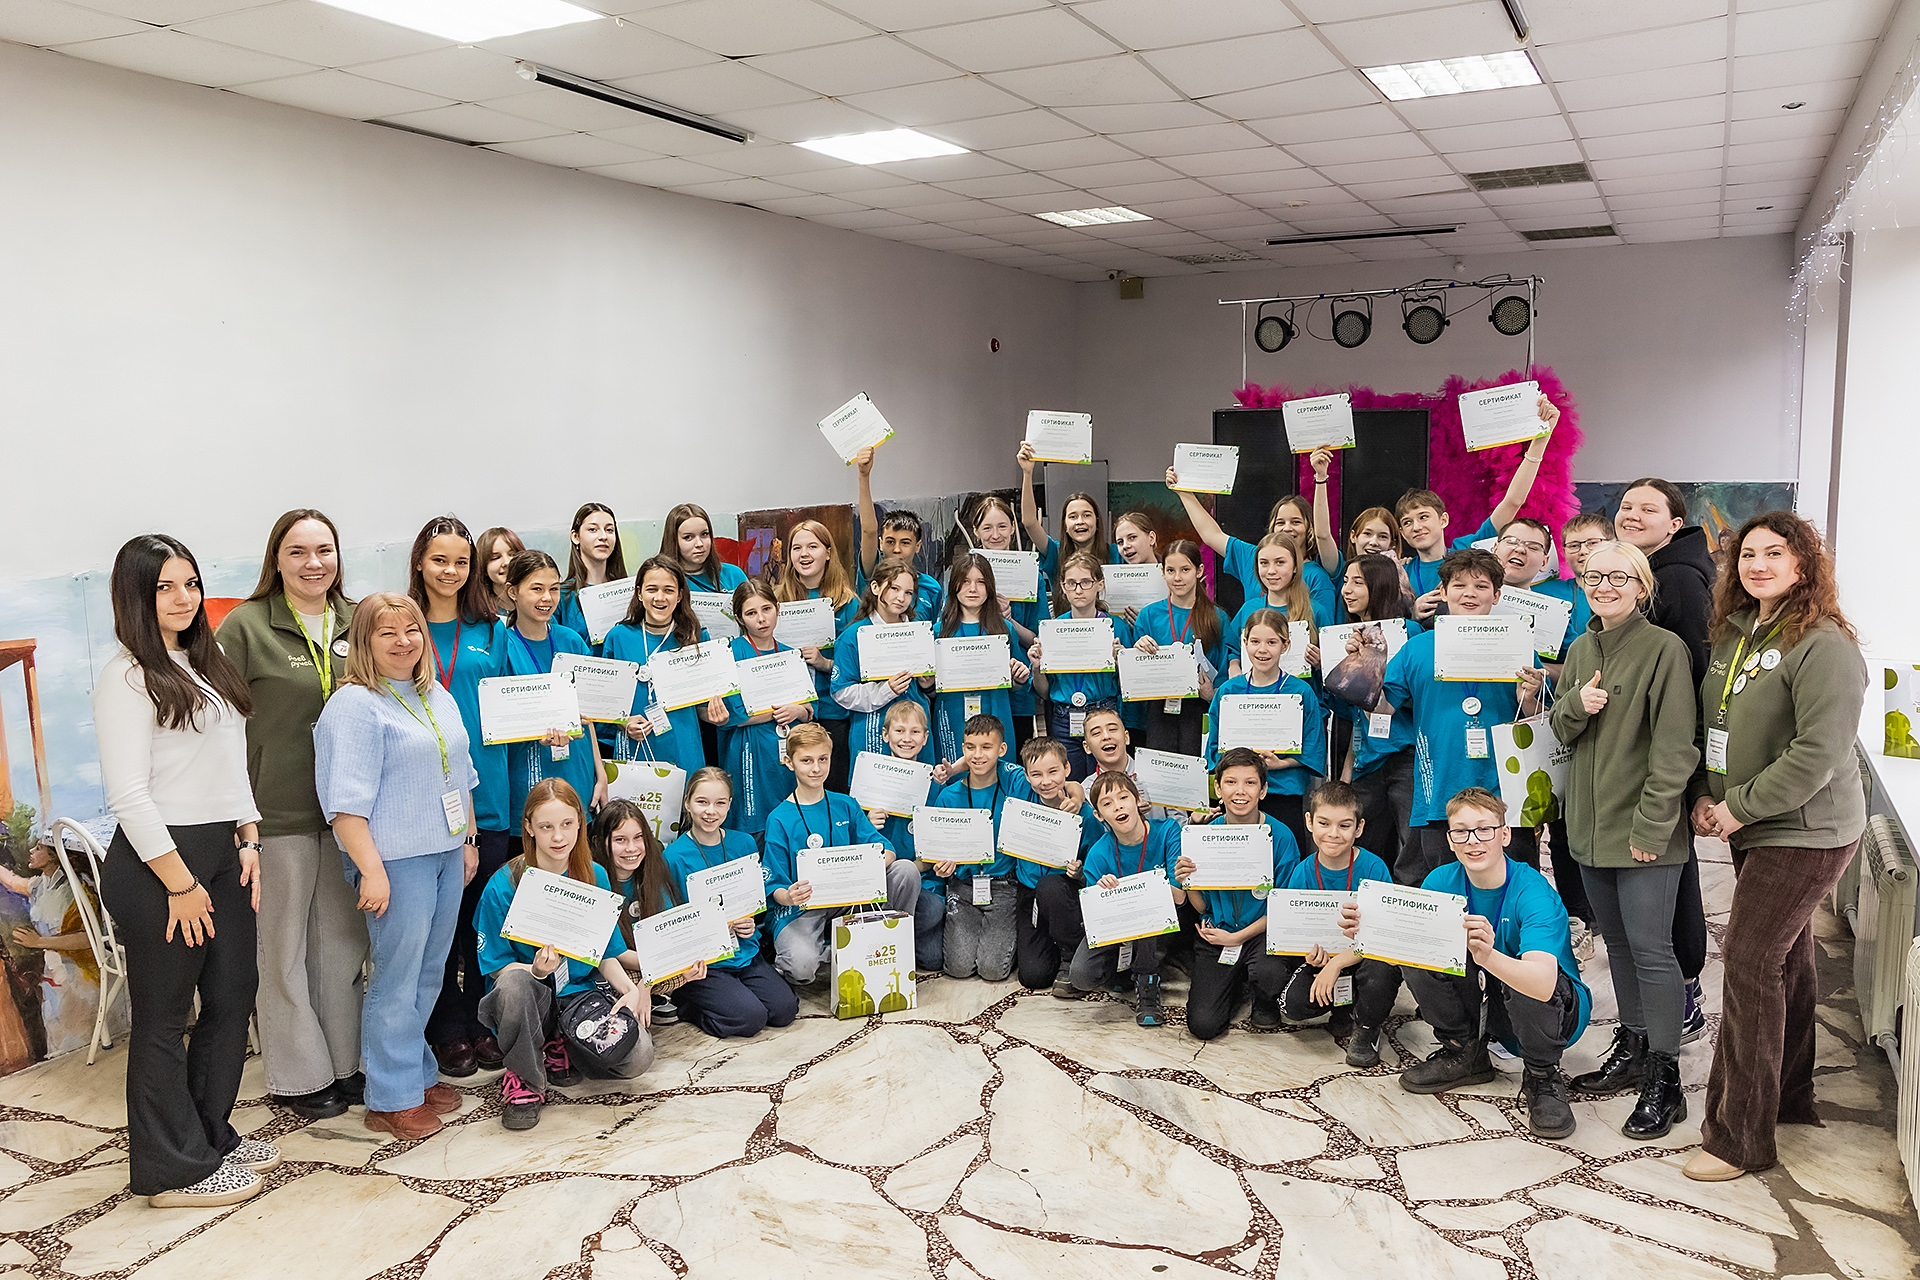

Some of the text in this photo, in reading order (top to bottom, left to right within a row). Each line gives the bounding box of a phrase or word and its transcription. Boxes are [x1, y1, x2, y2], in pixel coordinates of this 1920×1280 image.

[1478, 392, 1522, 406] СЕРТИФИКАТ
[1296, 404, 1333, 414] СЕРТИФИКАТ
[832, 407, 859, 428] СЕРТИФИКАТ
[1041, 418, 1075, 427] СЕРТИФИКАТ
[1189, 451, 1223, 459] СЕРТИФИКАТ
[598, 586, 635, 600] СЕРТИФИКА
[1502, 594, 1548, 611] СЕРТИФИКАТ
[1056, 626, 1095, 634] СЕРТИФИКАТ
[1458, 624, 1509, 632] СЕРТИФИКАТ
[875, 630, 914, 639] СЕРТИФИКАТ
[951, 644, 990, 652] СЕРТИФИКАТ
[668, 650, 712, 666] СЕРТИФИКАТ
[573, 664, 619, 677] СЕРТИФИКАТ
[751, 660, 787, 673] СЕРТИФИКАТ
[501, 683, 551, 694] СЕРТИФИКАТ
[1238, 703, 1282, 711] СЕРТИФИКАТ
[874, 762, 914, 776] СЕРТИФИКАТ
[1150, 758, 1188, 770] СЕРТИФИКАТ
[930, 816, 972, 824] СЕРТИФИКАТ
[1020, 810, 1062, 826] СЕРТИФИКАТ
[817, 854, 863, 864] СЕРТИФИКАТ
[705, 868, 744, 886] СЕРТИФИКАТ
[544, 884, 596, 906] СЕРТИФИКАТ
[1100, 882, 1146, 898] СЕРТИФИКАТ
[1381, 896, 1438, 912] СЕРТИФИКАТ
[654, 910, 701, 932] СЕРТИФИКАТ
[882, 944, 896, 956] 25
[868, 956, 896, 967] ВМЕСТЕ
